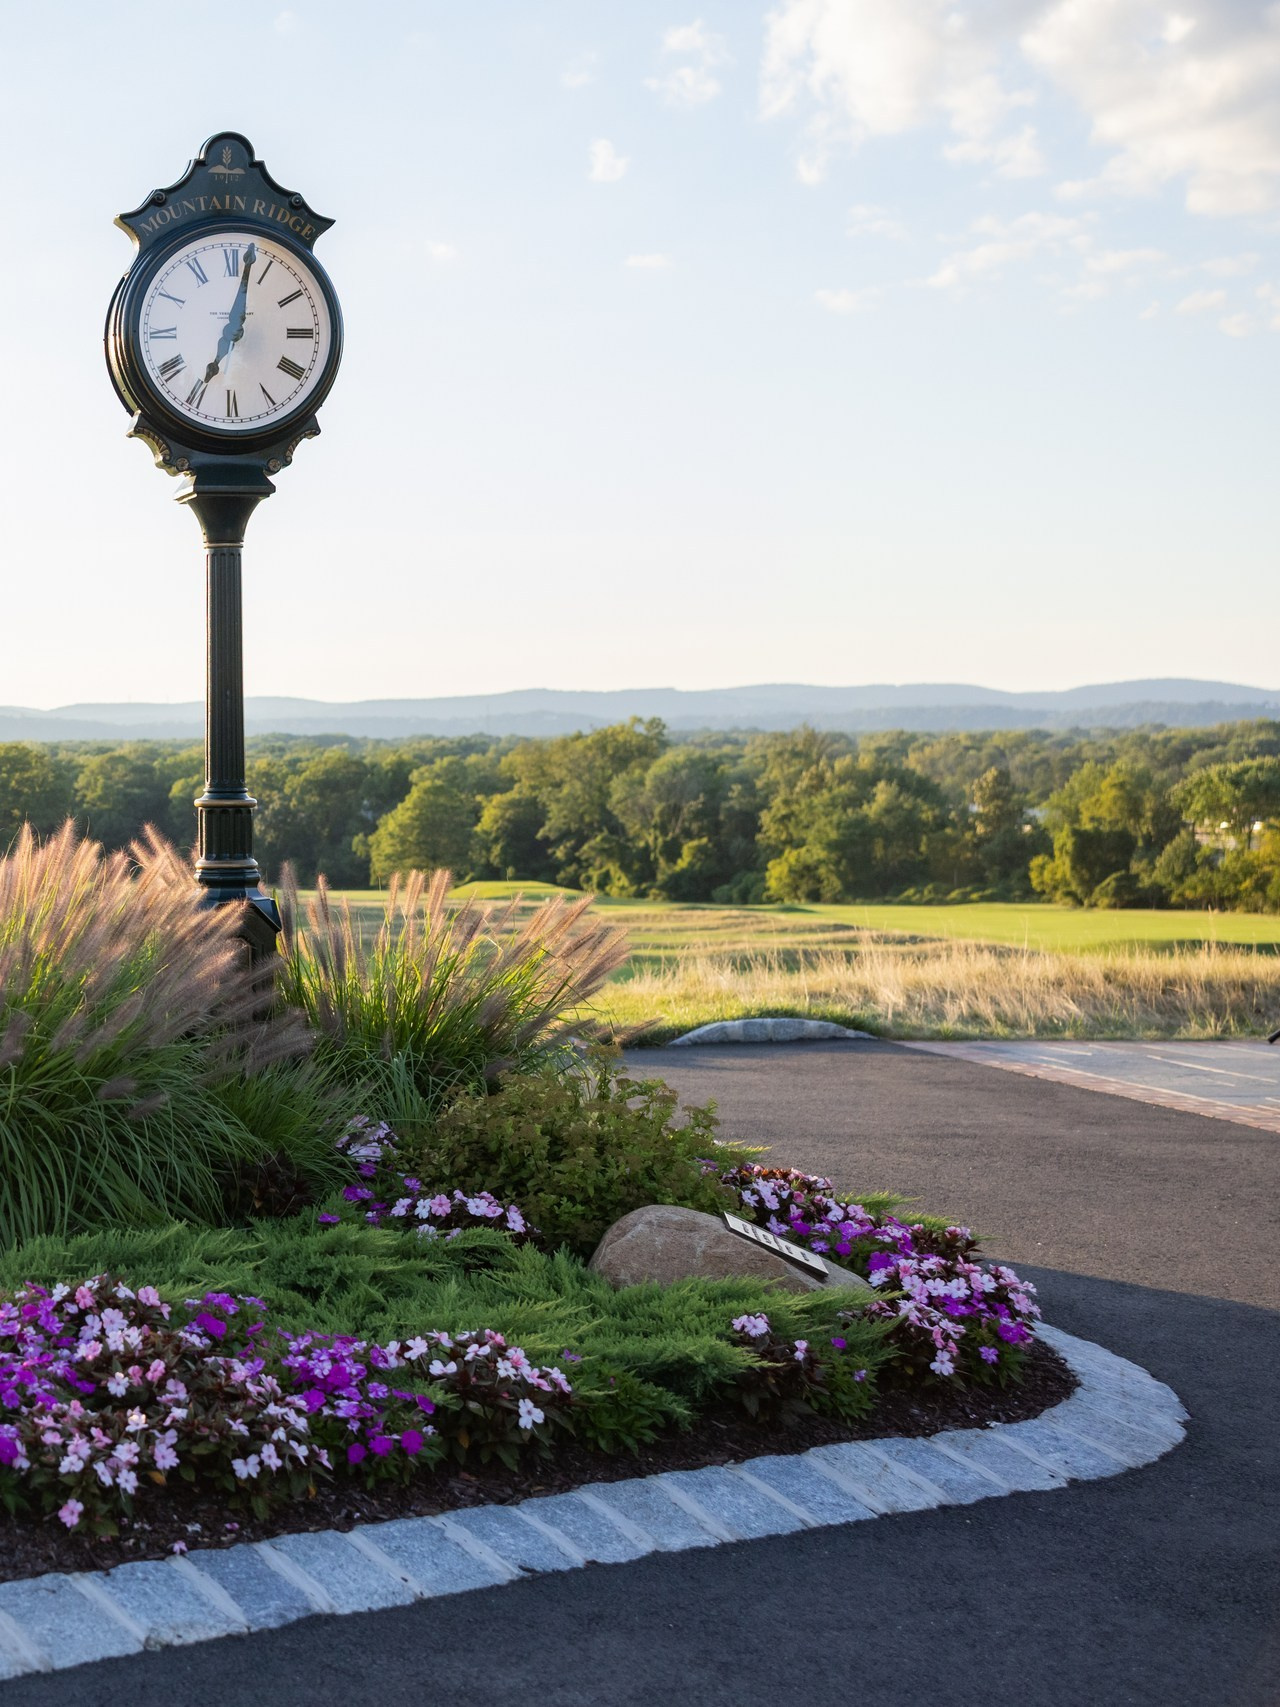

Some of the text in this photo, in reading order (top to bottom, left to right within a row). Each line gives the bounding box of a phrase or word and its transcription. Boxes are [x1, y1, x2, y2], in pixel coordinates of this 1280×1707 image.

[139, 194, 316, 241] MOUNTAIN RIDGE
[186, 257, 209, 288] XI
[223, 249, 240, 277] XII
[256, 260, 274, 285] I
[158, 287, 186, 309] X
[277, 289, 304, 308] II
[149, 326, 177, 340] IX
[286, 327, 314, 339] III
[226, 390, 240, 418] VI
[259, 382, 277, 409] V
